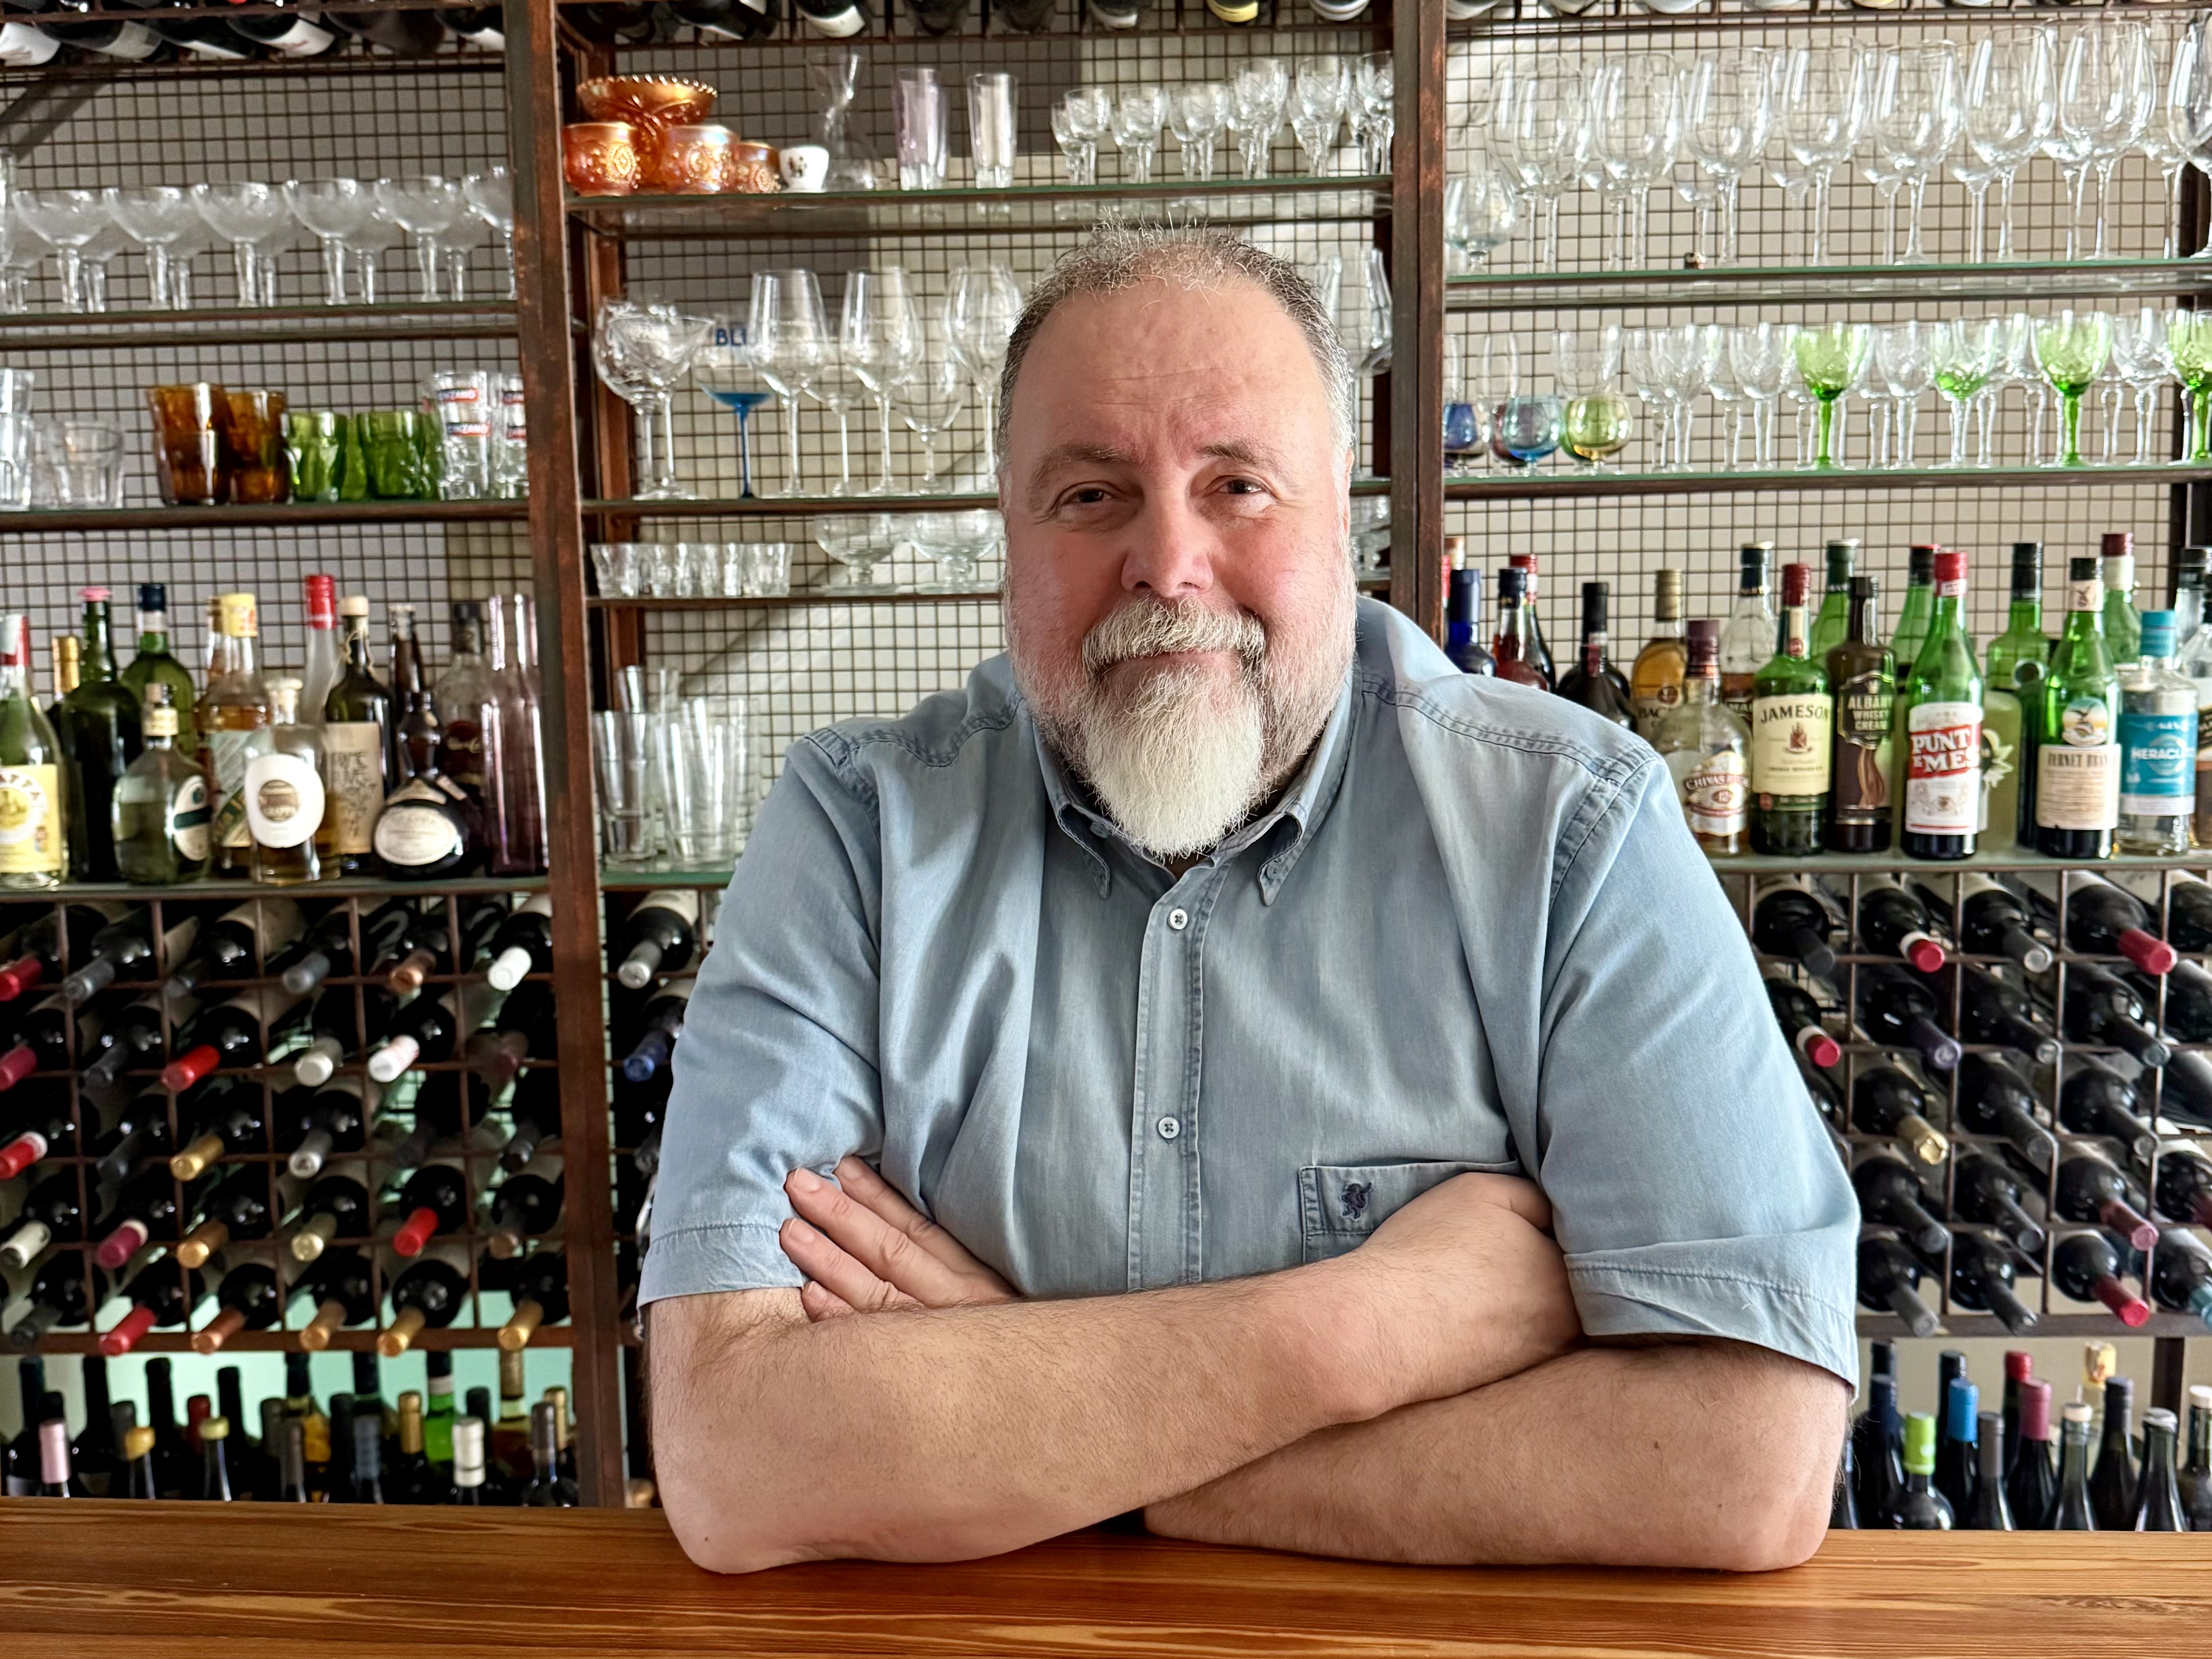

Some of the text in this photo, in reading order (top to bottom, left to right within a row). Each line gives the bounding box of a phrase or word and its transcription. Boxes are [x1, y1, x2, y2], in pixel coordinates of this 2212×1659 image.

[1761, 705, 1829, 724] JAMESON
[1911, 728, 1971, 754] PUNT
[1923, 749, 1980, 774] MES
[1685, 774, 1726, 791] CHIVAS
